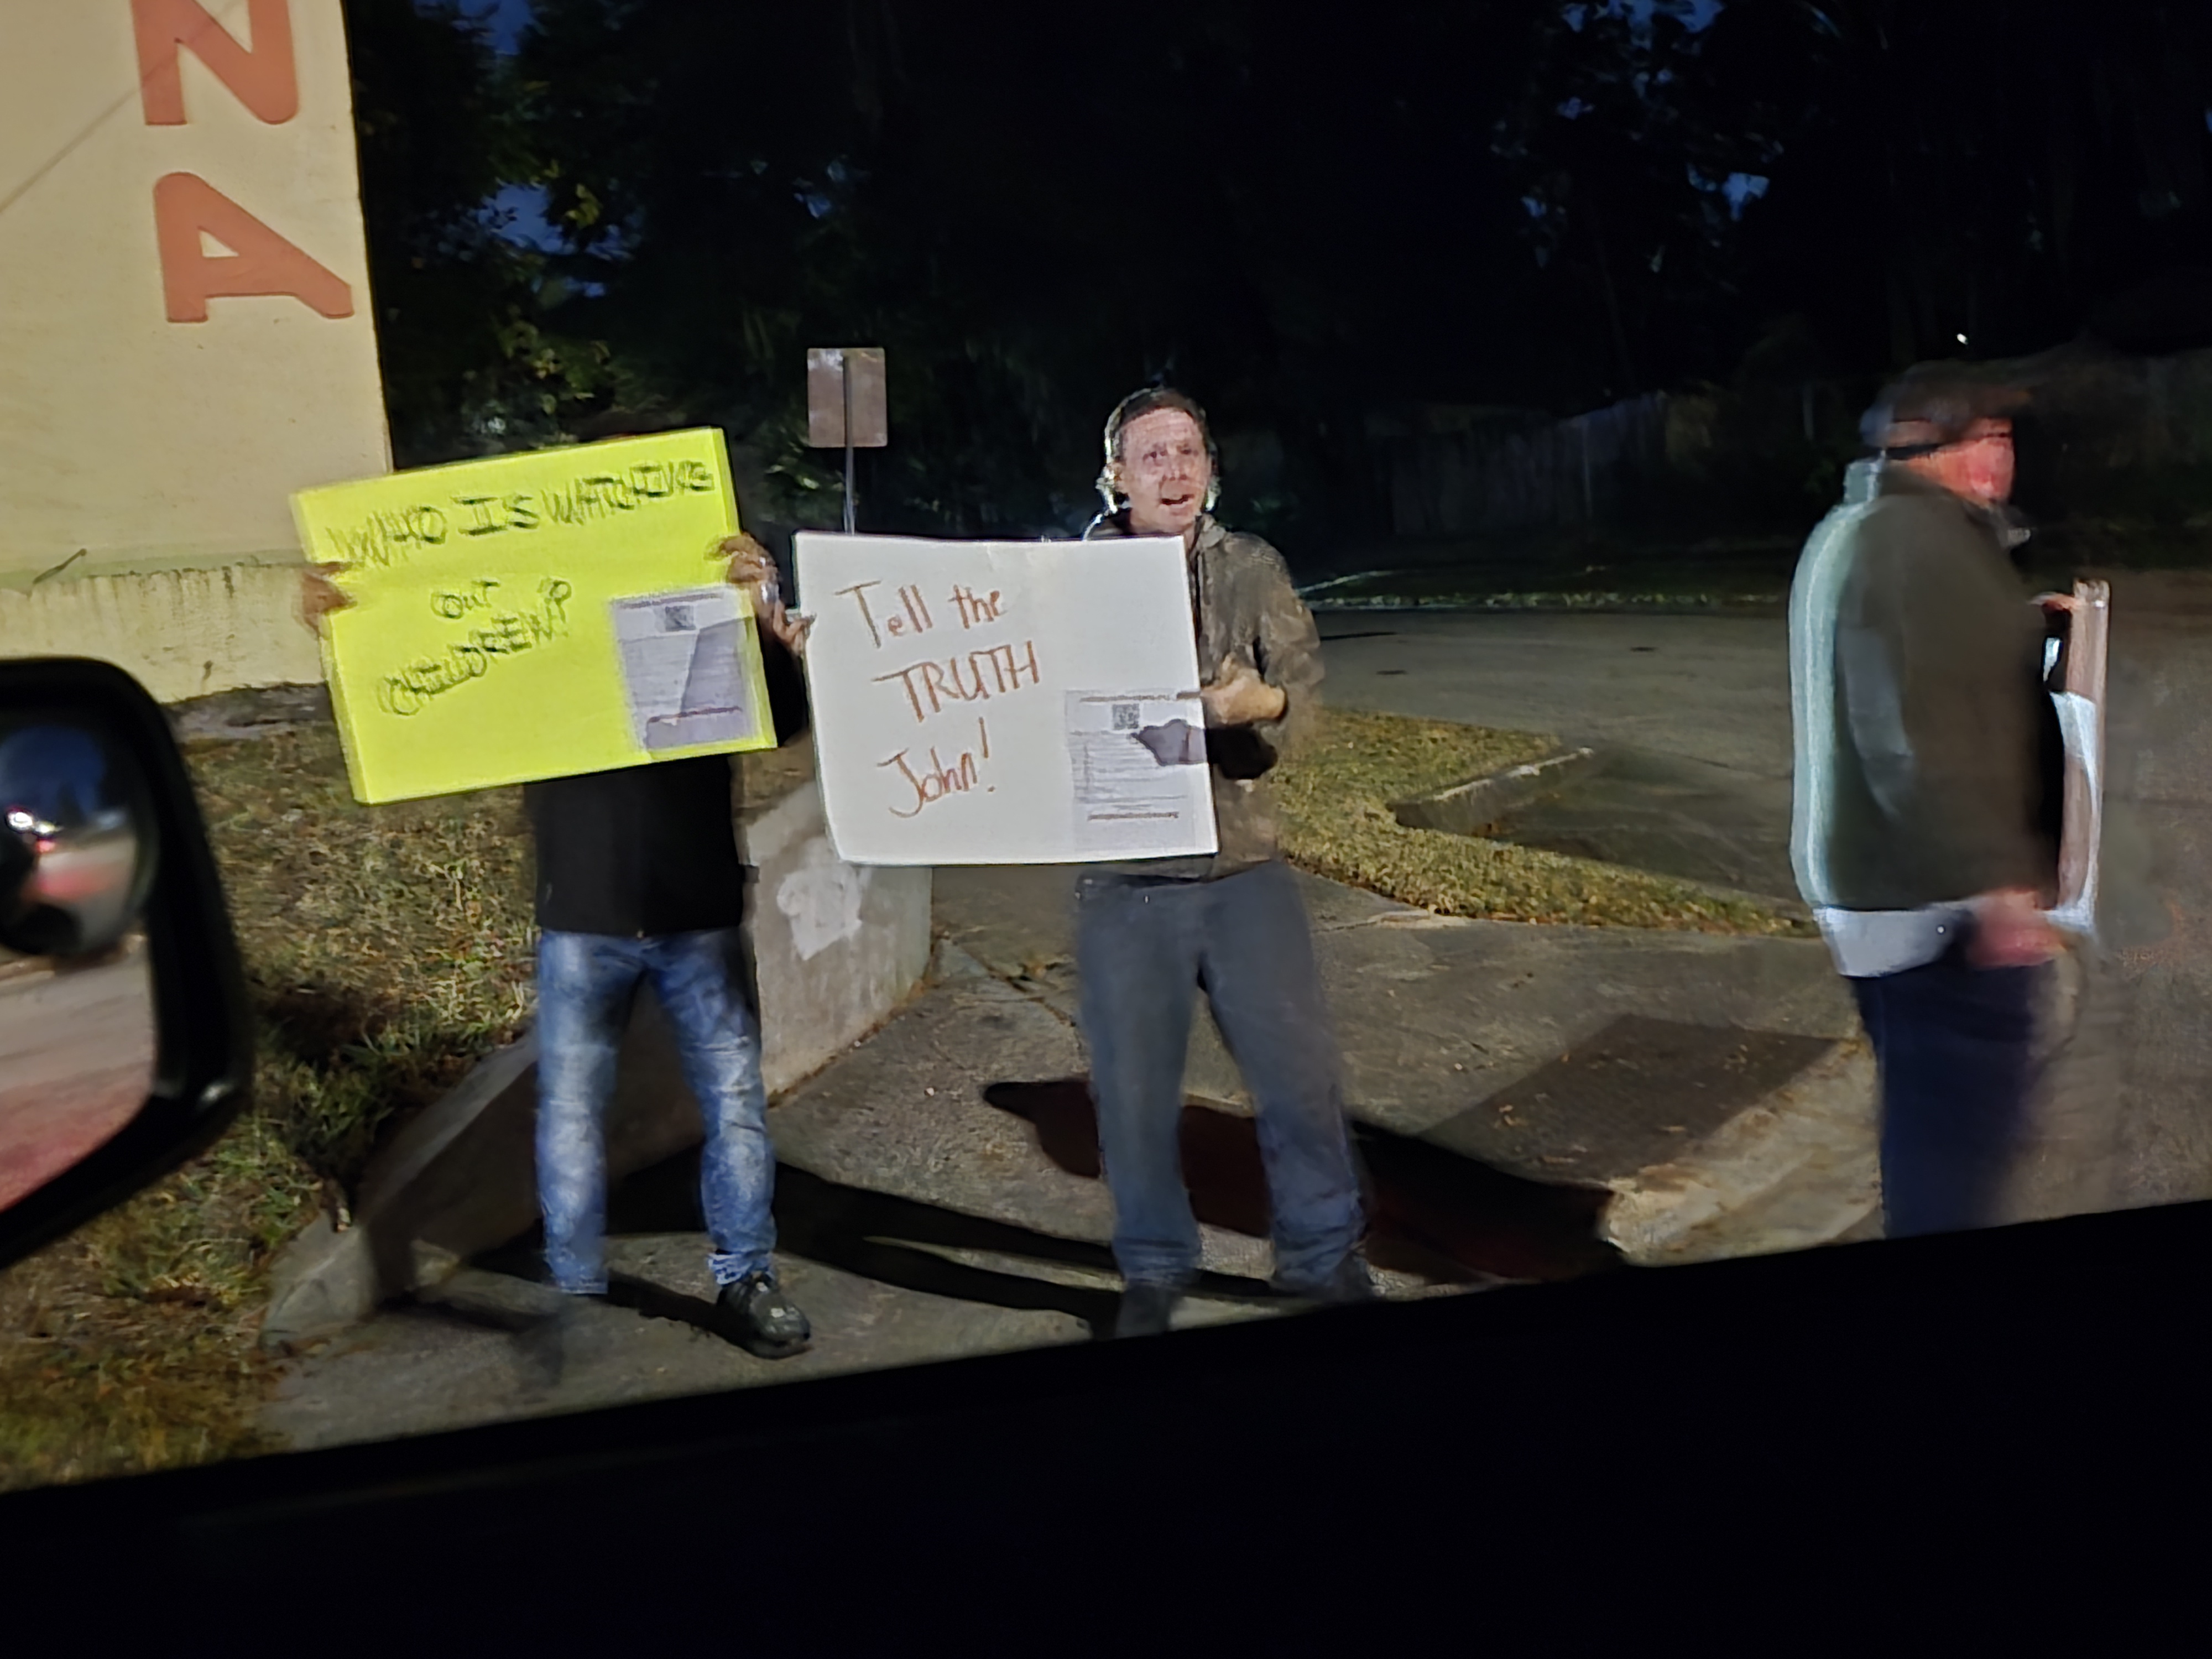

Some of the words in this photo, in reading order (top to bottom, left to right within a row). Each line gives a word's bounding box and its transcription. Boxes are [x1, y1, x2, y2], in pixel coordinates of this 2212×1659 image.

[325, 504, 447, 567] WHO
[449, 492, 540, 536] IS
[540, 458, 716, 526] WATCHING
[834, 580, 935, 649] Tell
[947, 583, 1009, 630] the
[871, 640, 1040, 723] TRUTH
[877, 717, 996, 819] John!
